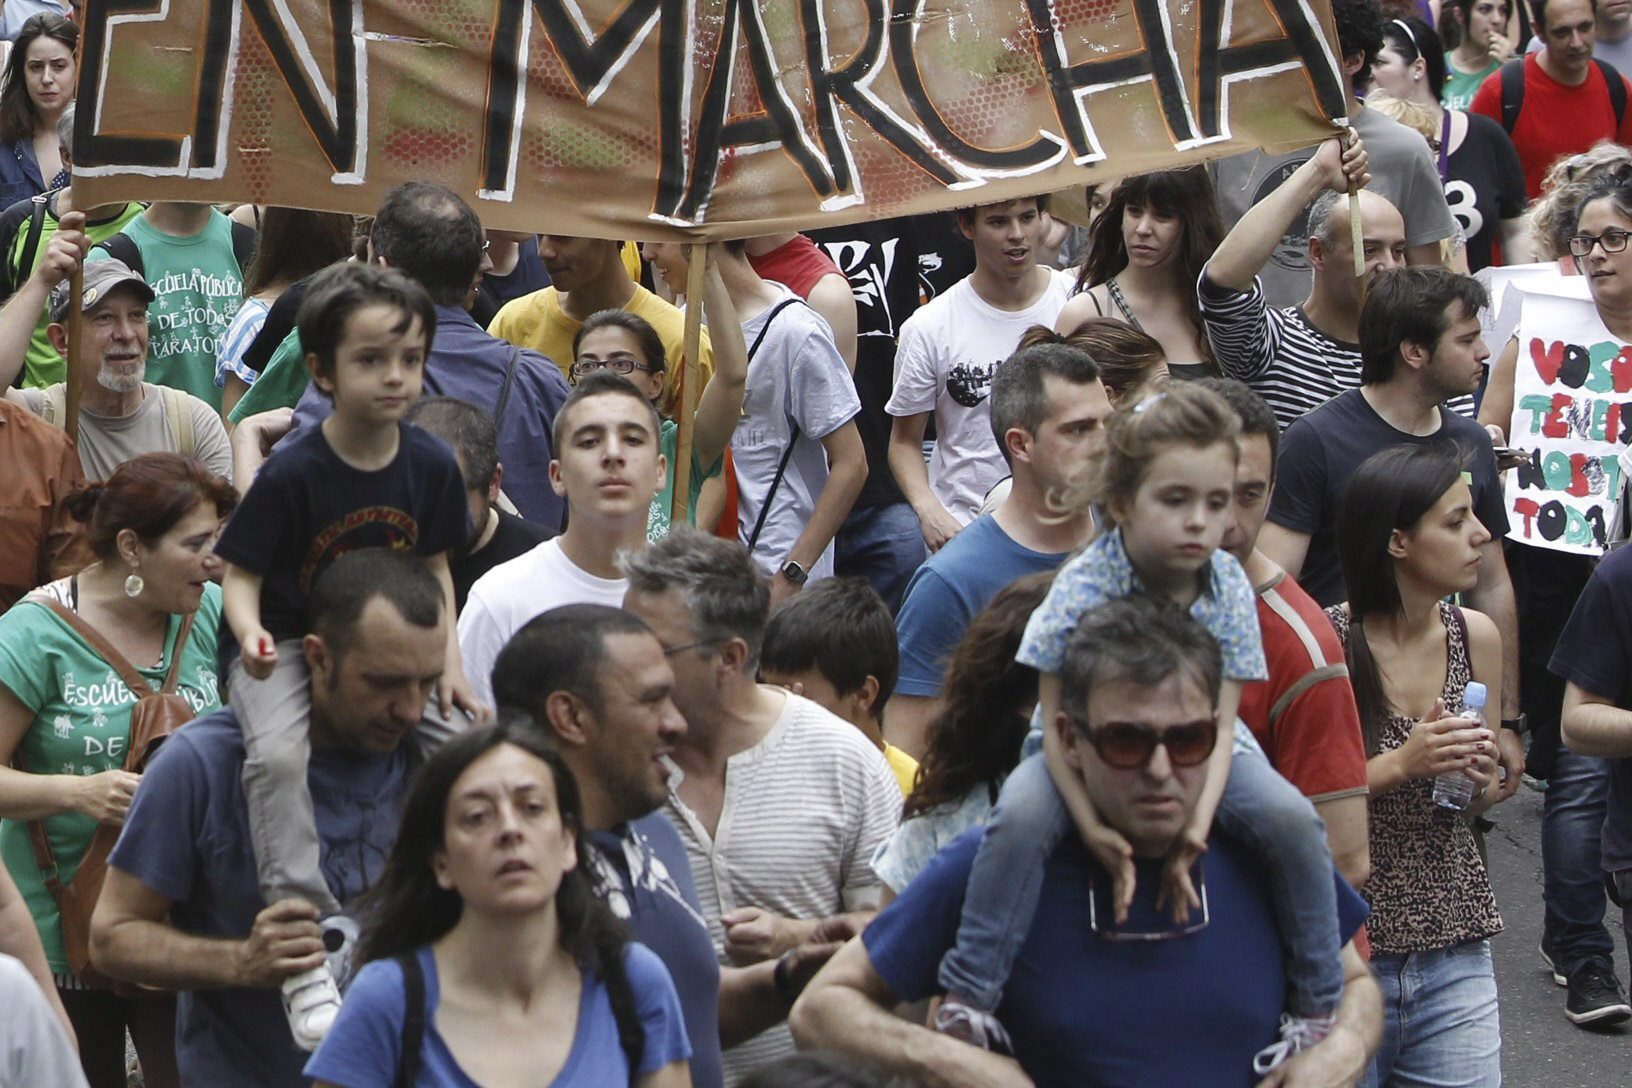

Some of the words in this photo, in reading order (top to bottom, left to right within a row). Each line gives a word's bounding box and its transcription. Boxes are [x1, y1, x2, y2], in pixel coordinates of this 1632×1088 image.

[150, 272, 199, 297] SCUELA
[158, 311, 183, 330] DE
[150, 339, 193, 359] PARA
[83, 735, 124, 757] DE
